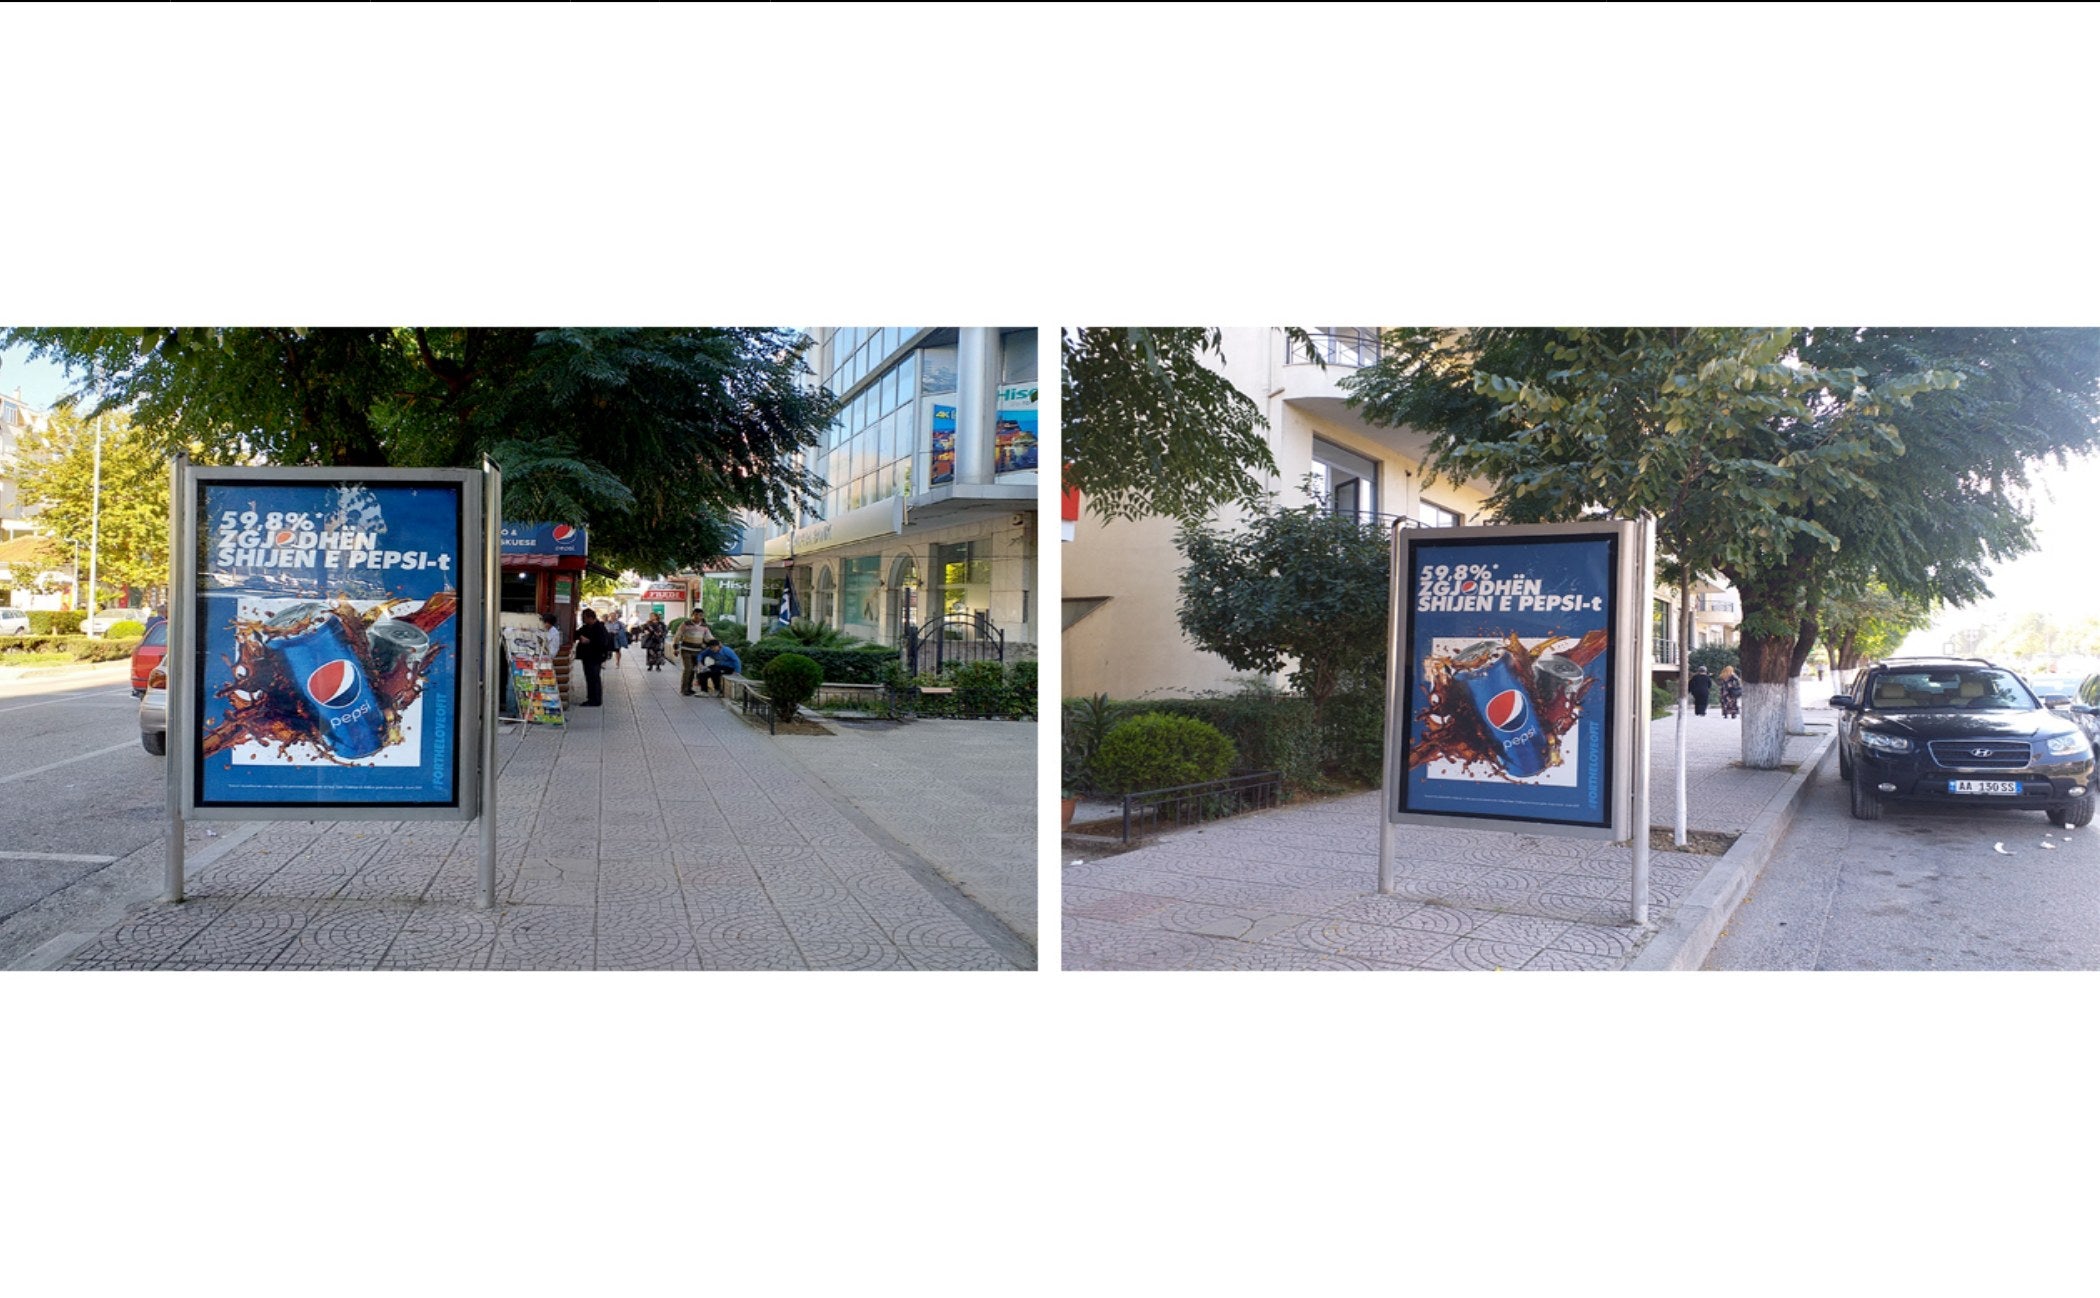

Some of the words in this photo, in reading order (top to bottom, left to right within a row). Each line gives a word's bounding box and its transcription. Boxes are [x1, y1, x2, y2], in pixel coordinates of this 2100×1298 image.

[216, 548, 317, 568] SHIJEN
[323, 549, 341, 568] E
[346, 550, 451, 570] PEPSI-t
[1417, 595, 1492, 612] SHIJEN
[1499, 595, 1512, 612] E
[1518, 594, 1602, 612] PEPSI-t
[330, 699, 372, 729] pepsi
[1503, 726, 1538, 750] pepsi
[1959, 782, 1973, 791] AA
[2001, 782, 2014, 792] SS
